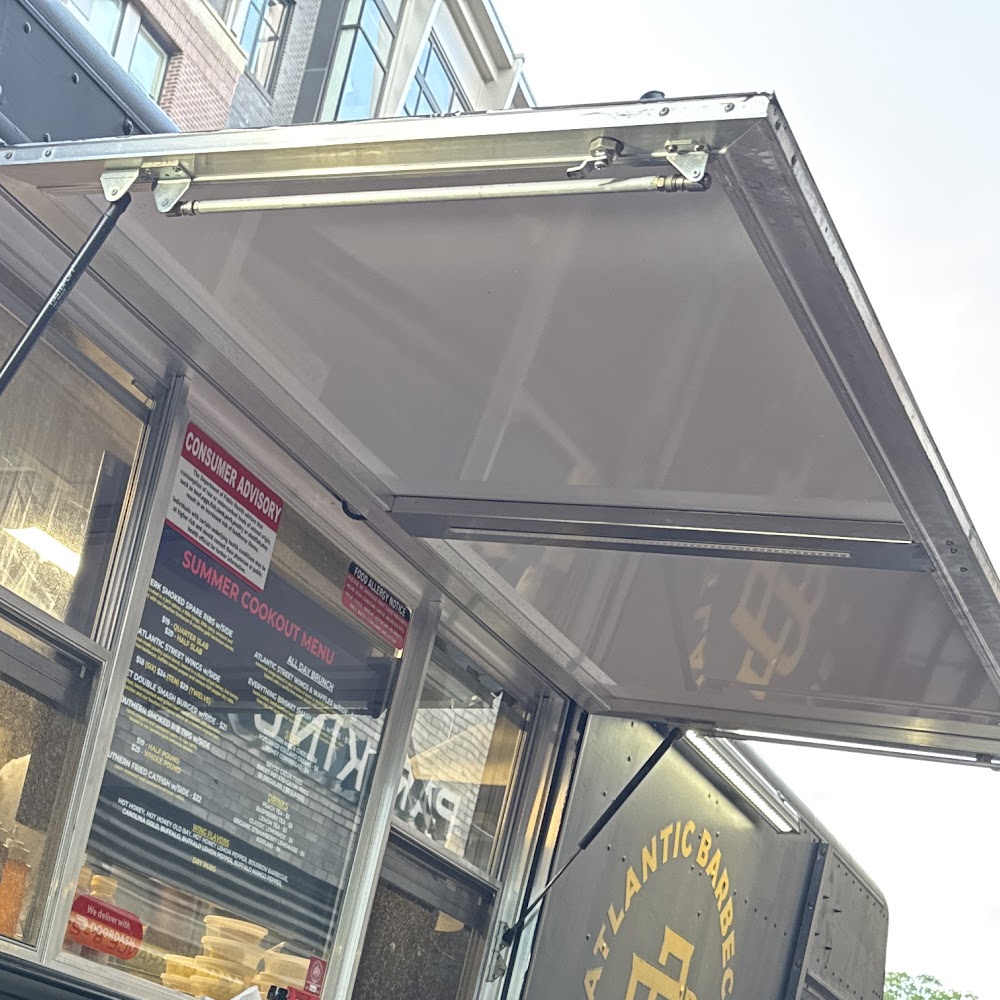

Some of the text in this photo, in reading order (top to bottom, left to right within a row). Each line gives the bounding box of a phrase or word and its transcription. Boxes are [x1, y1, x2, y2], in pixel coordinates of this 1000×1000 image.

[184, 430, 238, 489] CONSUMER
[236, 473, 281, 524] ADVISORY
[149, 577, 161, 591] ERK
[161, 585, 185, 606] SMOKED
[185, 600, 203, 618] SPARE
[202, 612, 215, 626] RIBS
[181, 547, 240, 602] SUMMER
[240, 588, 300, 643] COOKOUT
[300, 629, 335, 666] MENU
[353, 566, 368, 585] FOOD
[367, 577, 389, 603] ALLERGY
[388, 595, 406, 617] NOTICE
[137, 626, 164, 648] ATLANTIC
[164, 642, 184, 660] STREET
[184, 655, 203, 672] WINGS
[172, 622, 196, 642] QUARTER
[196, 636, 209, 650] SLAB
[176, 633, 190, 648] HALF
[189, 642, 203, 656] SLAB
[133, 672, 157, 691] DOUBLE
[156, 685, 176, 702] SMASH
[176, 696, 198, 714] BURGER
[253, 650, 277, 671] ATLANTIC
[276, 665, 293, 681] STREET
[293, 675, 309, 691] WINGS
[313, 688, 333, 706] WAFFLES
[286, 654, 334, 693] ALL DAY BRUNCH
[121, 694, 147, 715] OUTHERN
[146, 709, 170, 728] SMOKED
[247, 677, 277, 701] EVERYTHING
[276, 695, 295, 712] BRISKET
[130, 761, 147, 776] FRIED
[147, 769, 170, 787] CATFISH
[87, 904, 131, 930] We deliver with
[90, 922, 136, 946] DOORDASH
